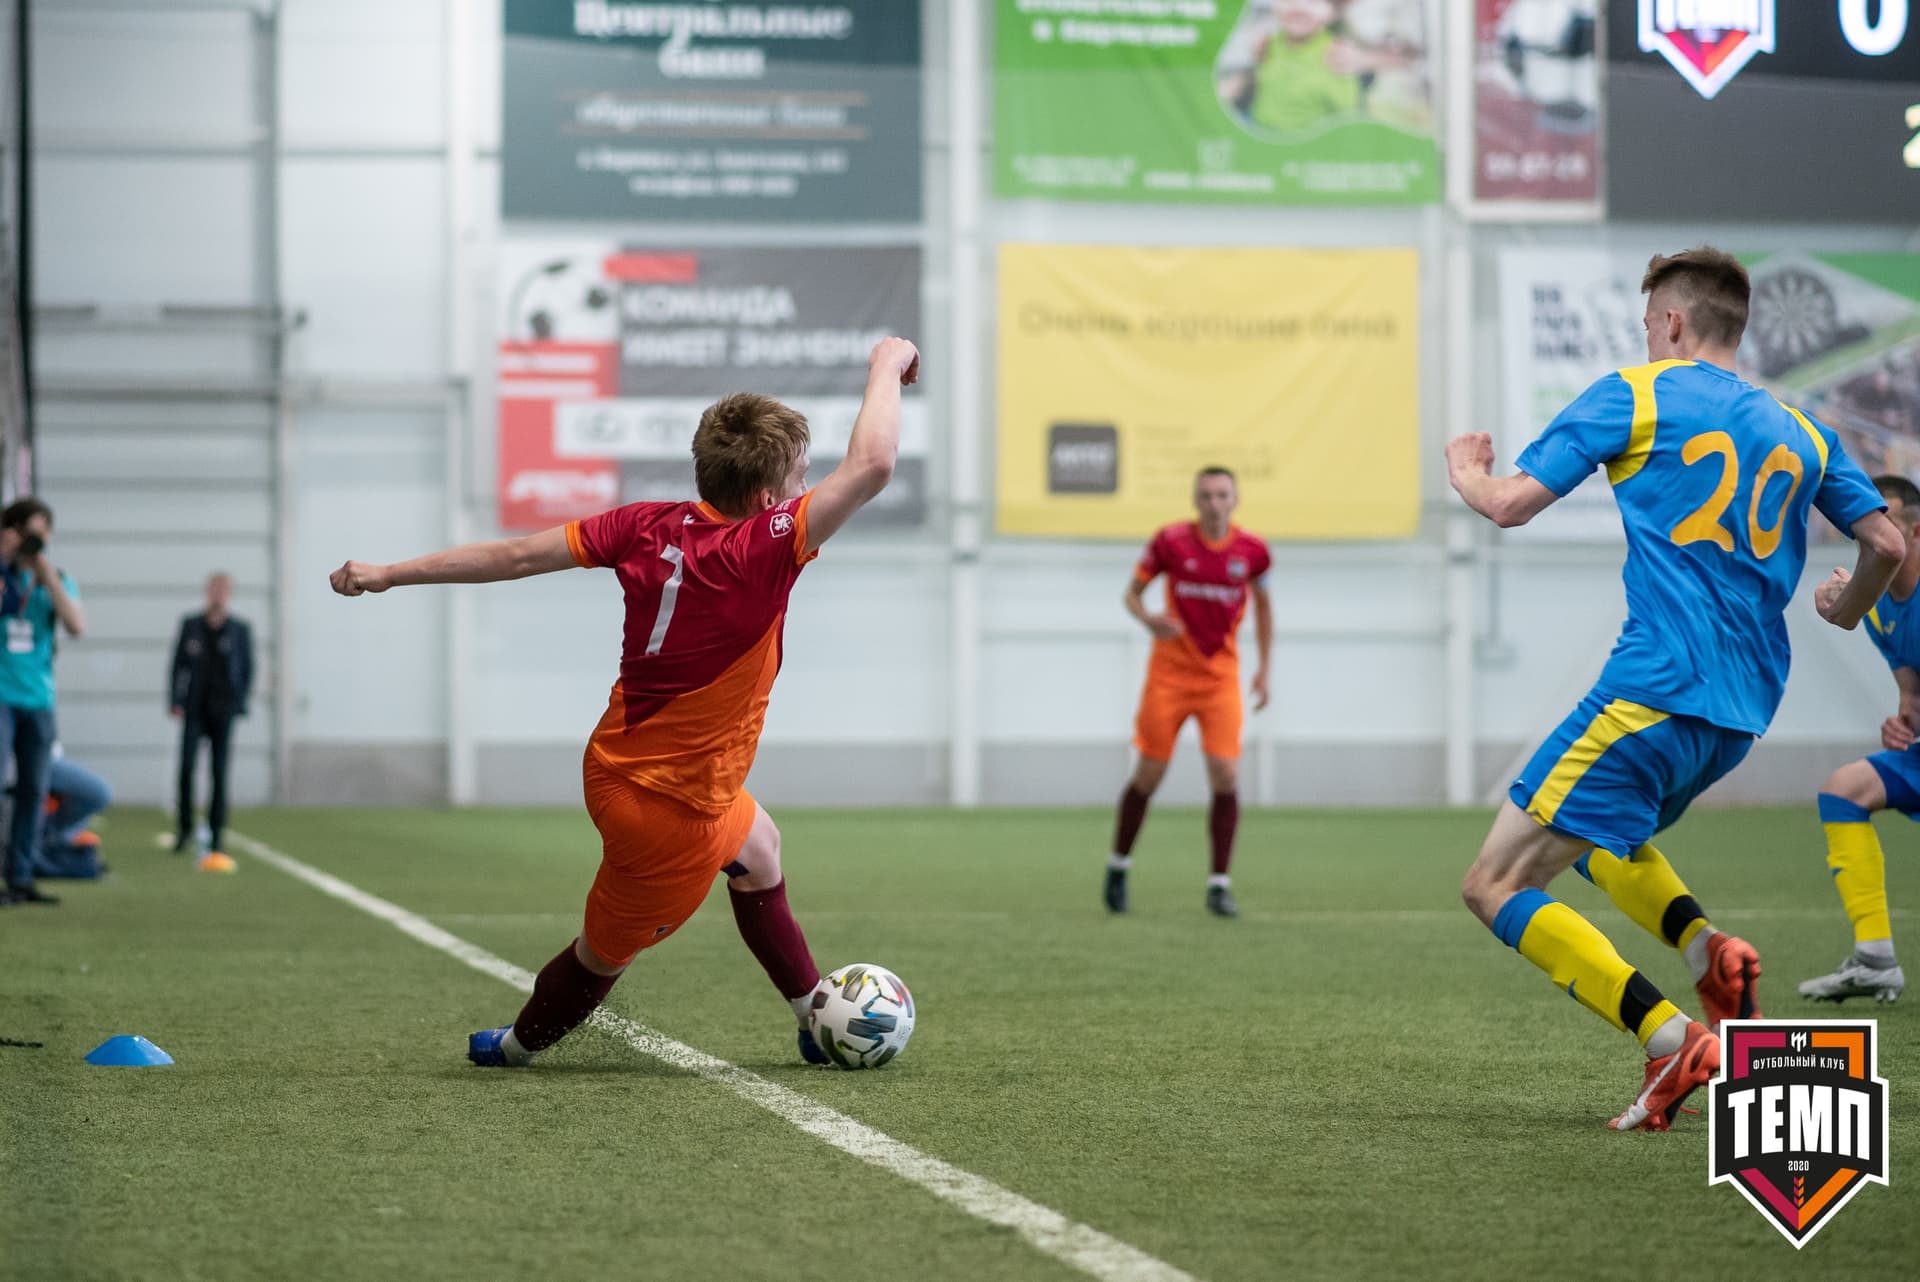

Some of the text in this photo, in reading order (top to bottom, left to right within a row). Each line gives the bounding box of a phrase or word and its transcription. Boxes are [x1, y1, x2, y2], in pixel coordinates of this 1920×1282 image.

[623, 286, 798, 327] КОМАНДА
[623, 327, 727, 366] ИМЕЕТ
[1670, 430, 1803, 559] 20
